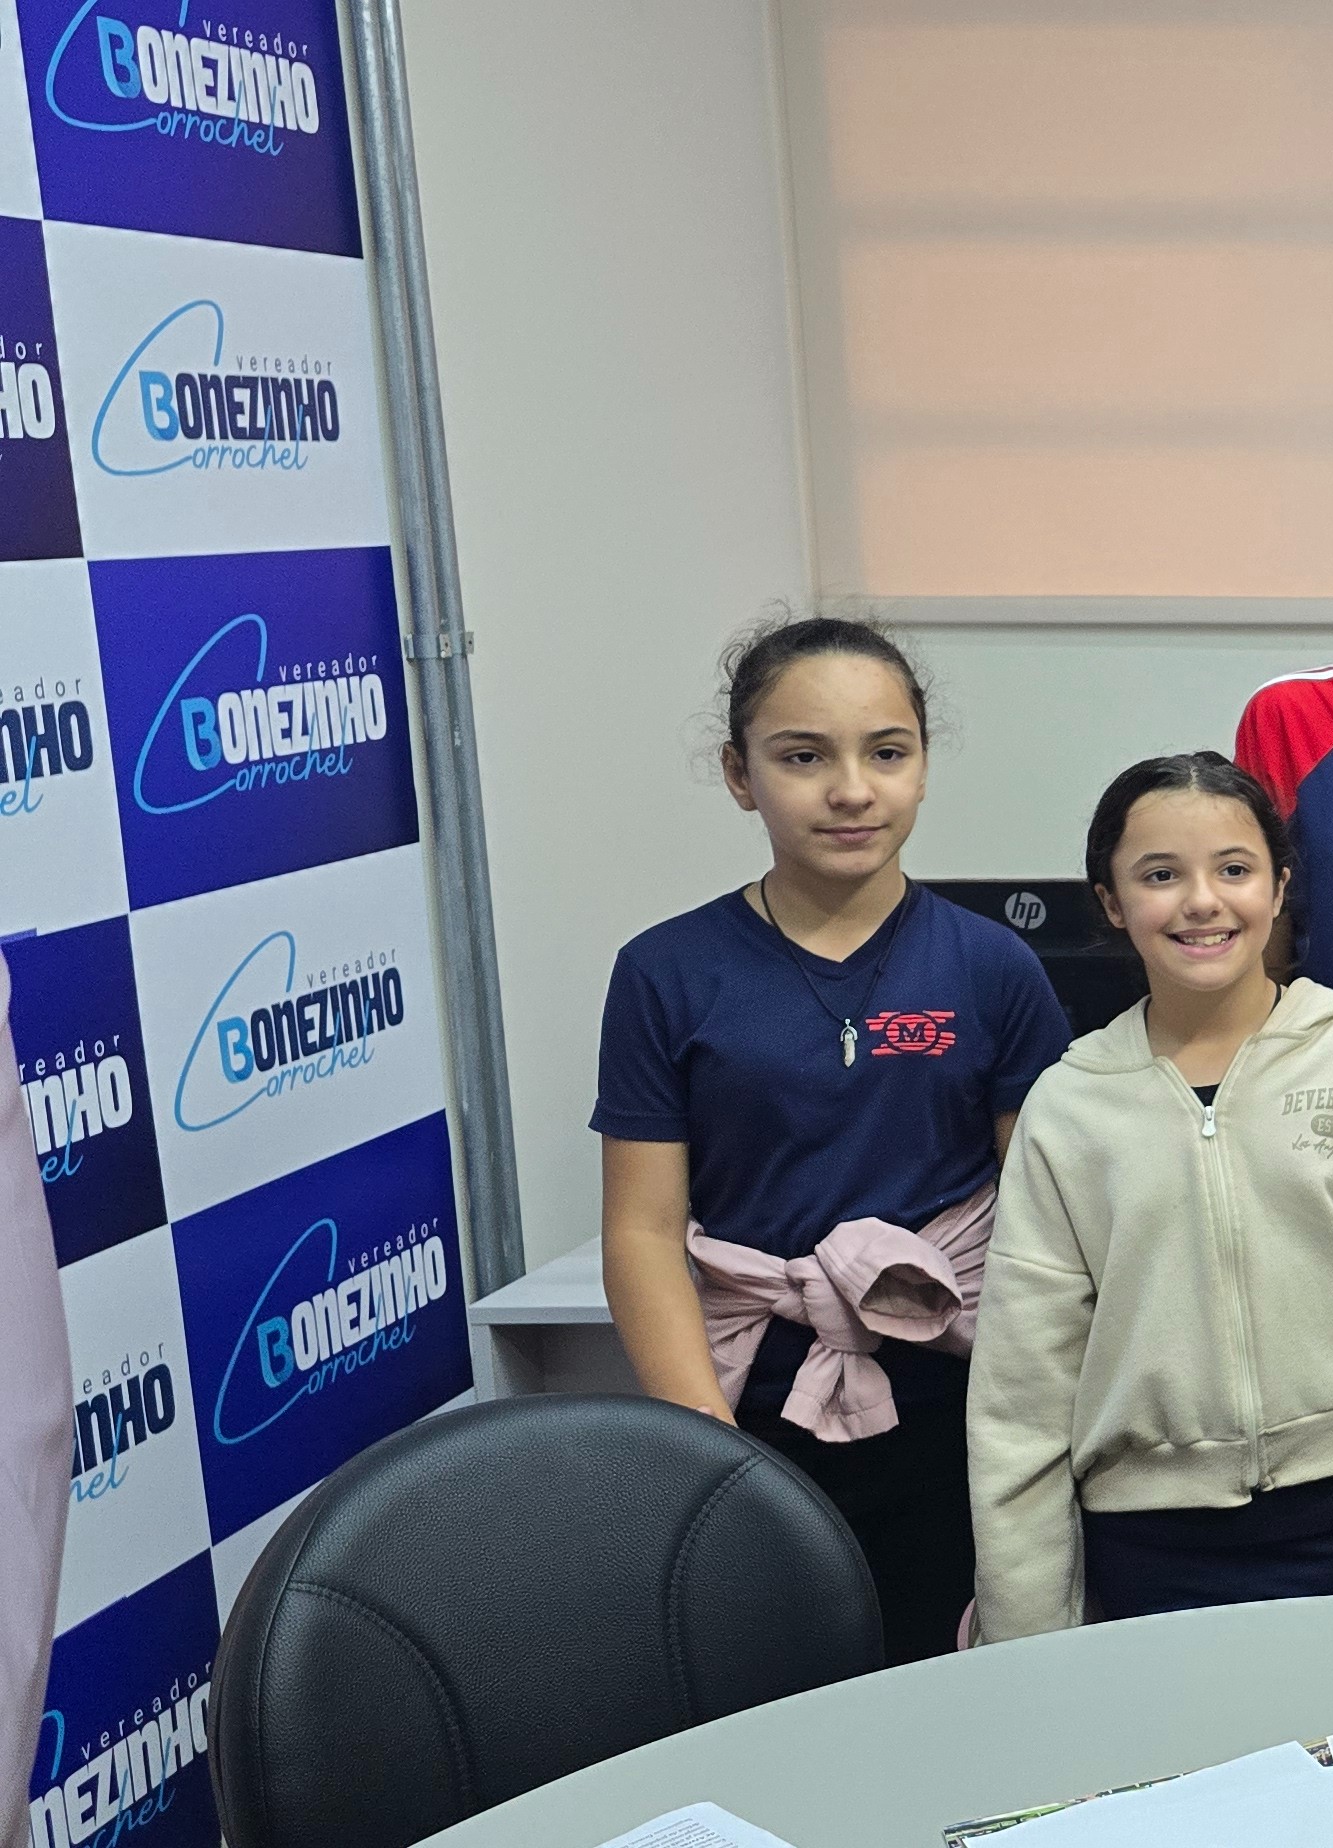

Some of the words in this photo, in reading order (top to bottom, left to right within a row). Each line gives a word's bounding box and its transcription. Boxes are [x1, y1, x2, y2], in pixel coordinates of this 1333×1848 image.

[203, 19, 309, 57] vereador
[46, 0, 283, 156] Corrochel
[92, 299, 308, 476] Corrochel
[236, 353, 332, 374] vereador
[0, 677, 81, 704] ador
[279, 655, 378, 682] vereador
[133, 614, 353, 814] Corrochel
[1007, 892, 1044, 929] hp
[306, 947, 397, 988] vereador
[174, 930, 375, 1131] Corrochel
[19, 1034, 120, 1082] reador
[347, 1216, 440, 1273] vereador
[213, 1218, 416, 1444] Corrochel
[83, 1342, 164, 1394] eador
[80, 1661, 211, 1760] vereador
[29, 1681, 211, 1848] NEZINHO
